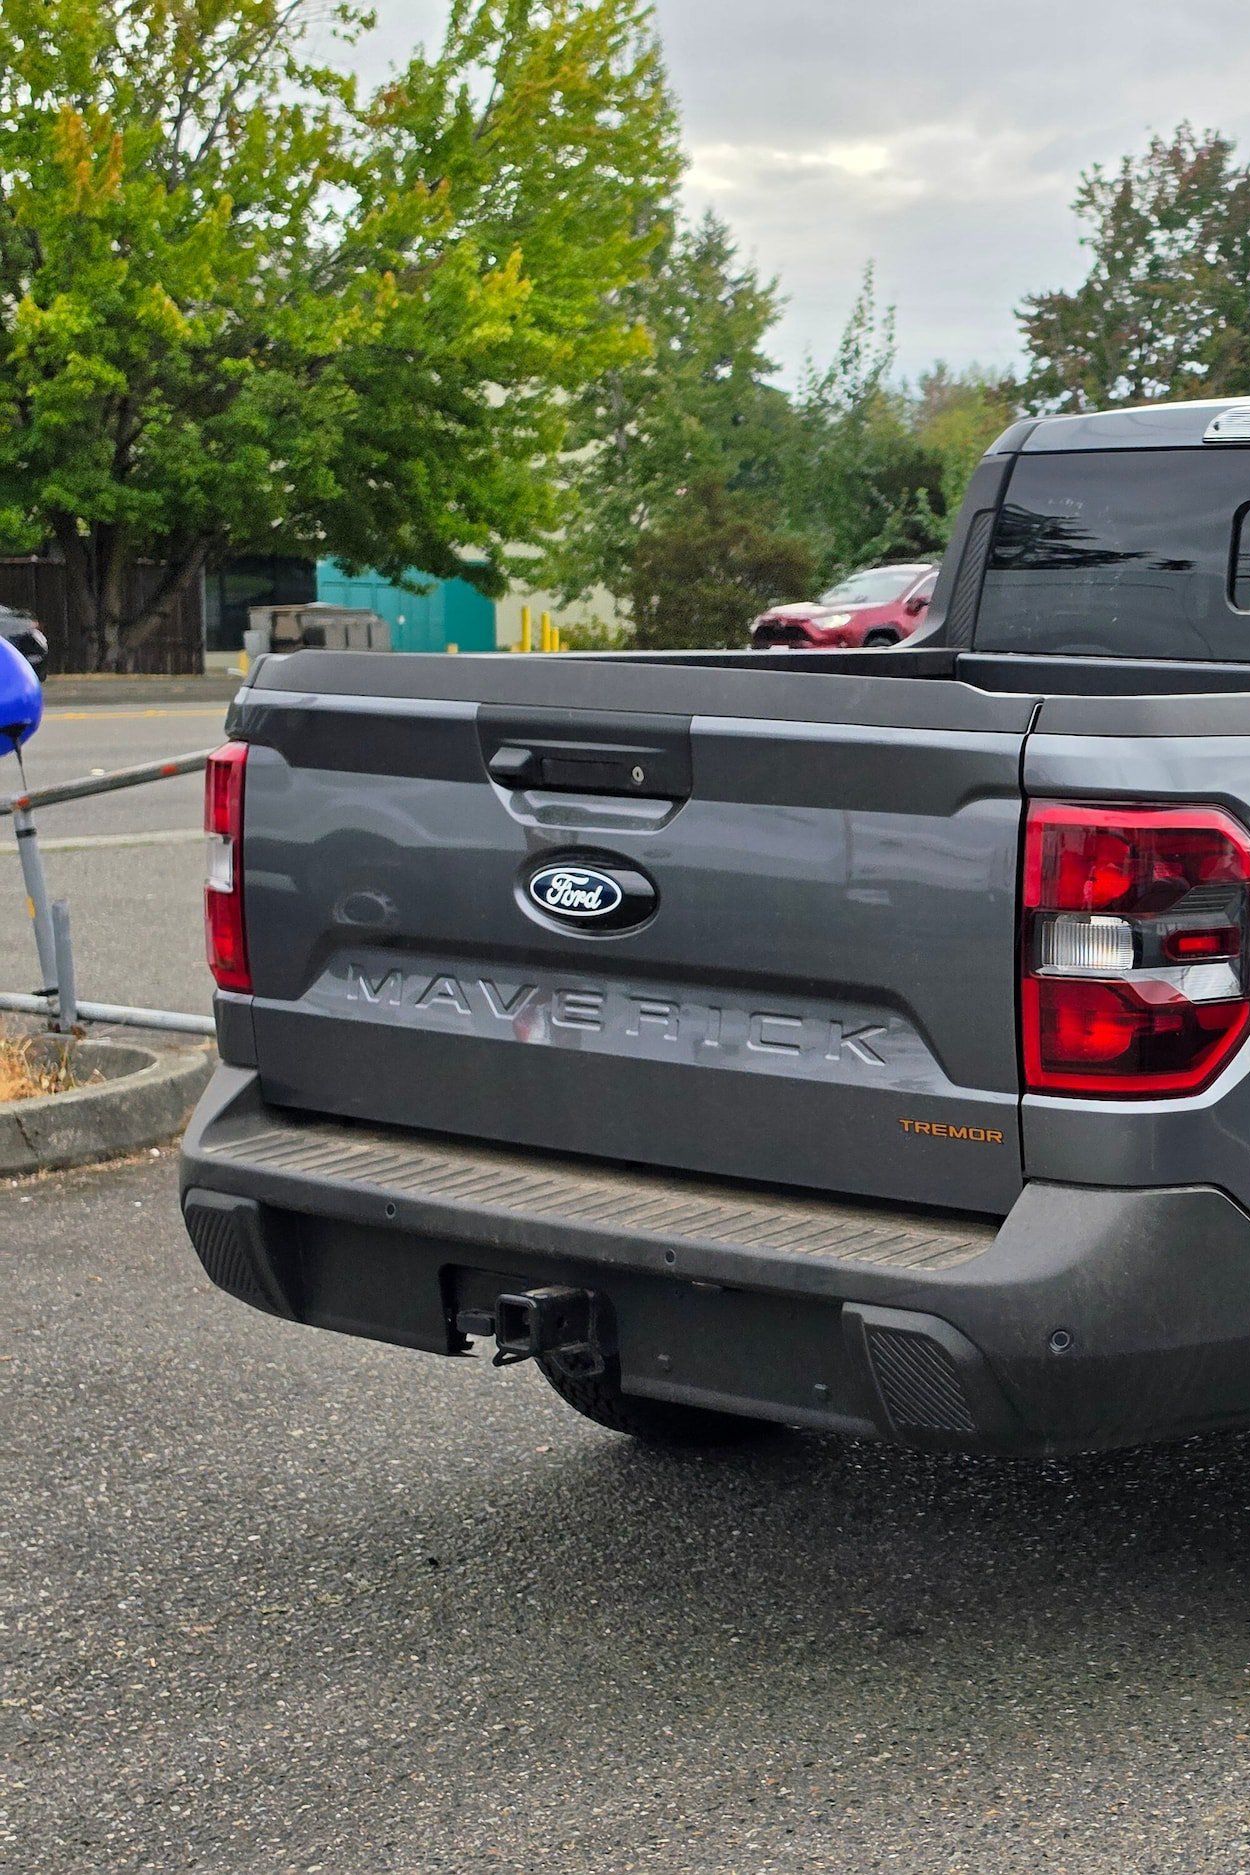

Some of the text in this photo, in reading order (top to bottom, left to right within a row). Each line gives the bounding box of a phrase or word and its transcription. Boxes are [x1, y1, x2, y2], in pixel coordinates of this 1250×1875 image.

[545, 873, 602, 910] Ford
[346, 961, 888, 1067] MAVERICK
[898, 1118, 1004, 1145] TREMOR
